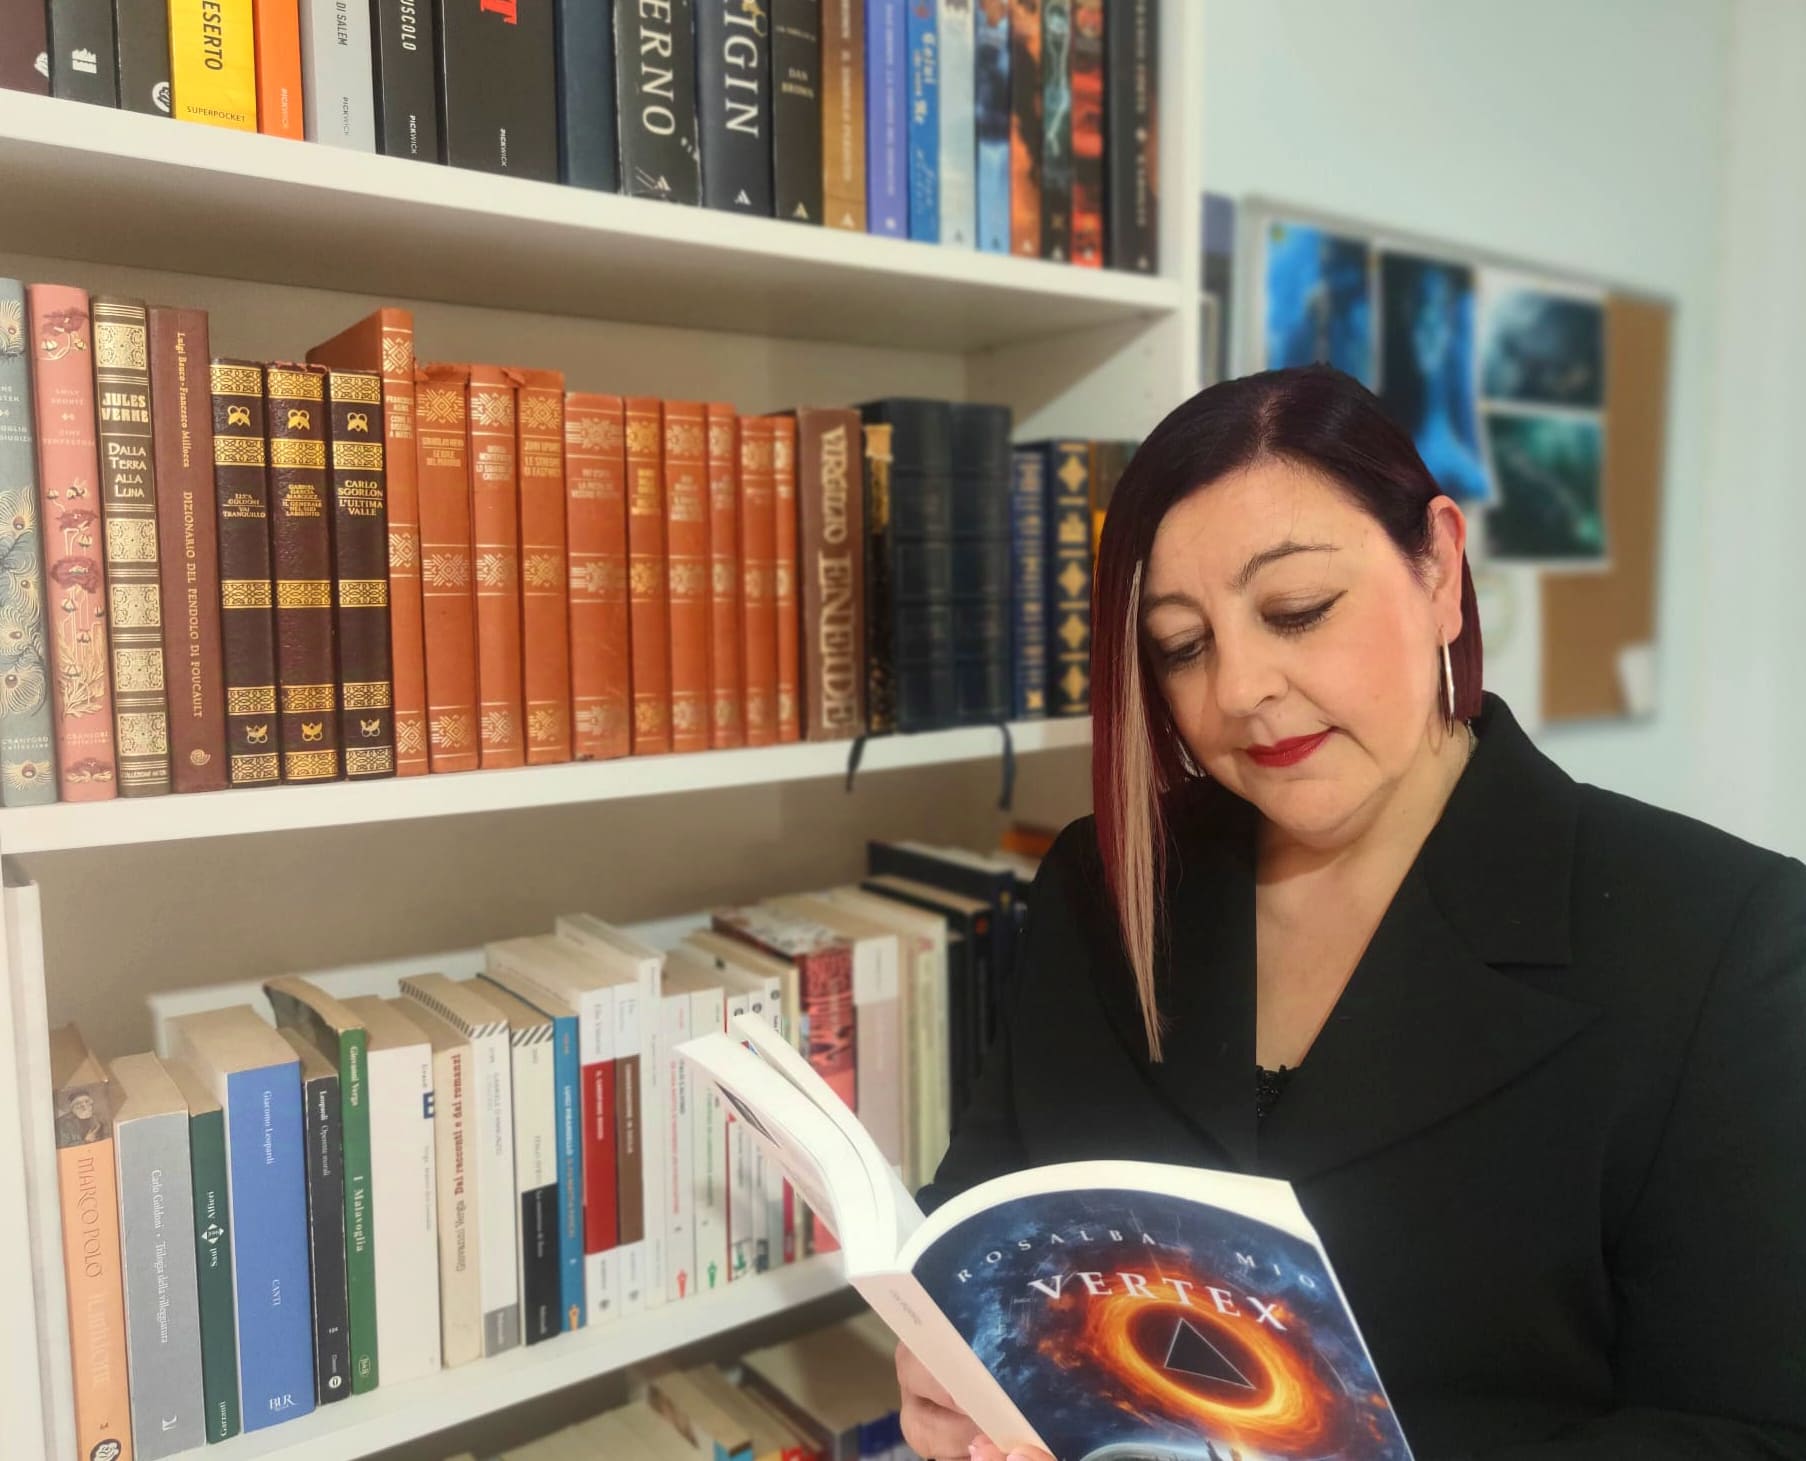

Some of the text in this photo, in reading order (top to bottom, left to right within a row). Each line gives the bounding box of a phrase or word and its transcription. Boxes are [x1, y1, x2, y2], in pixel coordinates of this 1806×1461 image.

[336, 14, 349, 47] SALEM
[723, 0, 760, 138] IGIN
[186, 105, 247, 123] SUPERPOCKET
[409, 114, 417, 154] PICKWICK
[499, 128, 508, 167] PICKWICK
[174, 332, 187, 355] Luigi
[102, 392, 147, 408] JULES
[179, 387, 189, 429] Francesco
[101, 407, 149, 423] VERNE
[108, 442, 147, 456] DALLA
[181, 430, 192, 468] Millocca
[108, 456, 147, 471] TERRA
[113, 484, 145, 499] LUNA
[115, 473, 143, 485] ALLA
[338, 488, 383, 497] SGORLON
[344, 480, 378, 489] CARLO
[223, 510, 266, 518] TRANQUILLO
[339, 500, 383, 508] L'ULTIMA
[348, 507, 377, 516] VALLE
[818, 425, 856, 729] VIRGILIO ENEIDE
[183, 492, 203, 718] DIZIONARIO DEL PENDOLO DI FOUCAULT
[451, 1054, 462, 1099] romanzi
[351, 1083, 361, 1107] Verga
[263, 1128, 276, 1165] Leopardi
[454, 1130, 463, 1174] racconti
[453, 1176, 464, 1196] Dai
[77, 1156, 103, 1279] MARCO POLO
[352, 1189, 366, 1252] Malavoglia
[151, 1169, 170, 1343] Carlo Goldoni Trilogia della villeggiatura
[956, 1229, 1316, 1290] ROSALBA MIO
[271, 1279, 282, 1306] CANTI
[1027, 1271, 1288, 1331] VERTEX
[269, 1393, 294, 1411] BUR
